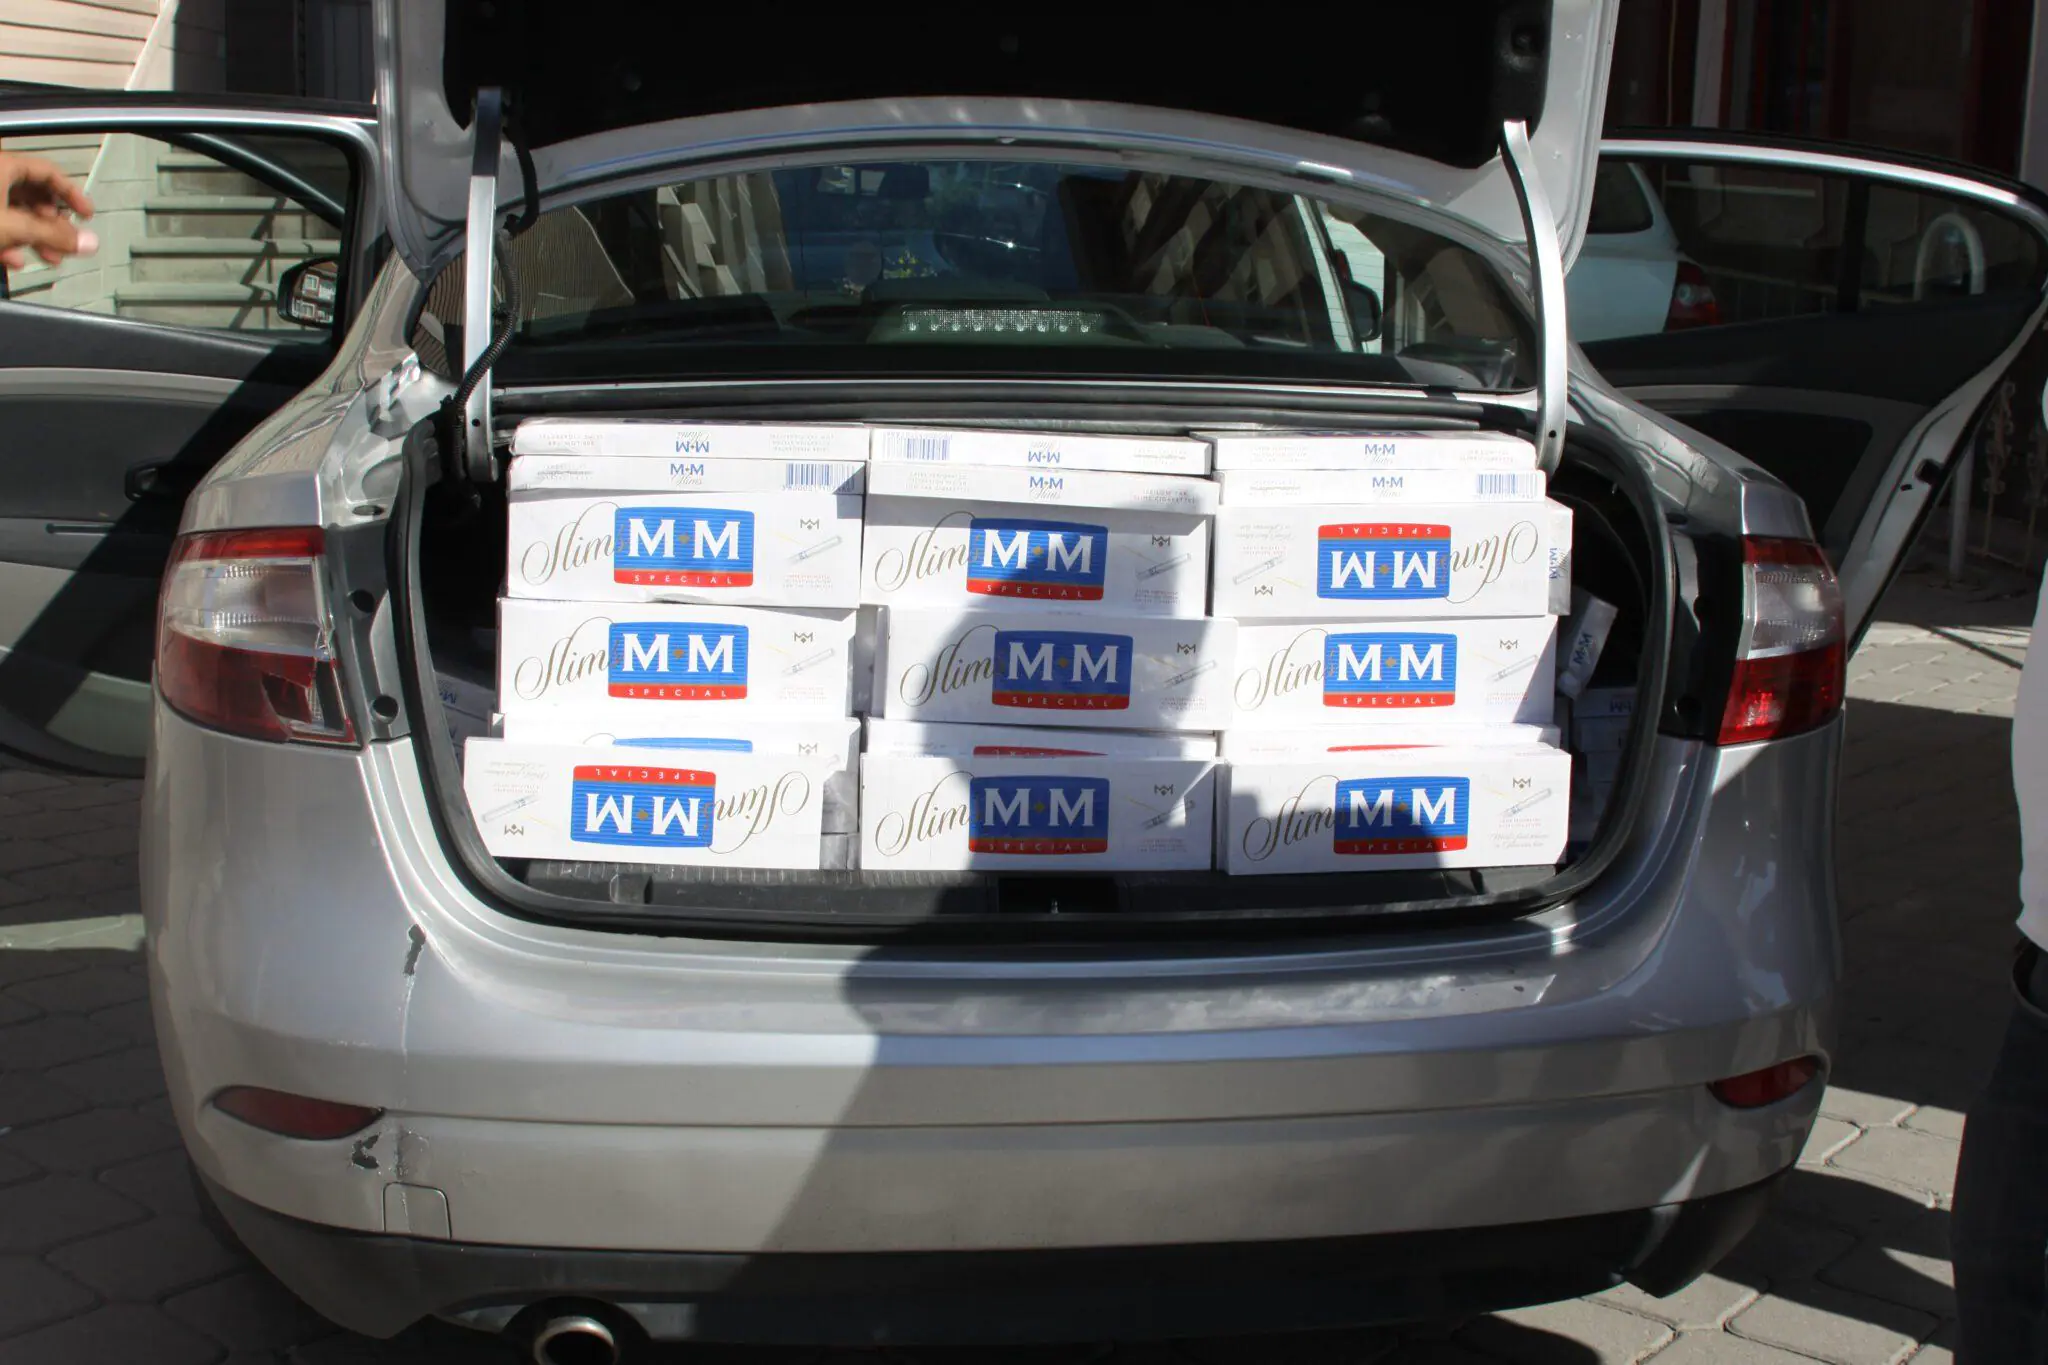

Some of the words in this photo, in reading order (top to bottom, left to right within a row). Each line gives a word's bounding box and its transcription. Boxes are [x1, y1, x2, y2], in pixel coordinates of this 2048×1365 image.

[1338, 527, 1432, 535] SPECIAL
[634, 574, 732, 584] SPECIAL
[986, 584, 1083, 597] SPECIAL
[629, 688, 727, 697] SPECIAL
[1012, 696, 1109, 707] SPECIAL
[1343, 697, 1435, 705] SPECIAL
[595, 768, 695, 780] SPECIAL
[989, 843, 1087, 851] SPECIAL
[1354, 842, 1448, 852] SPECIAL
